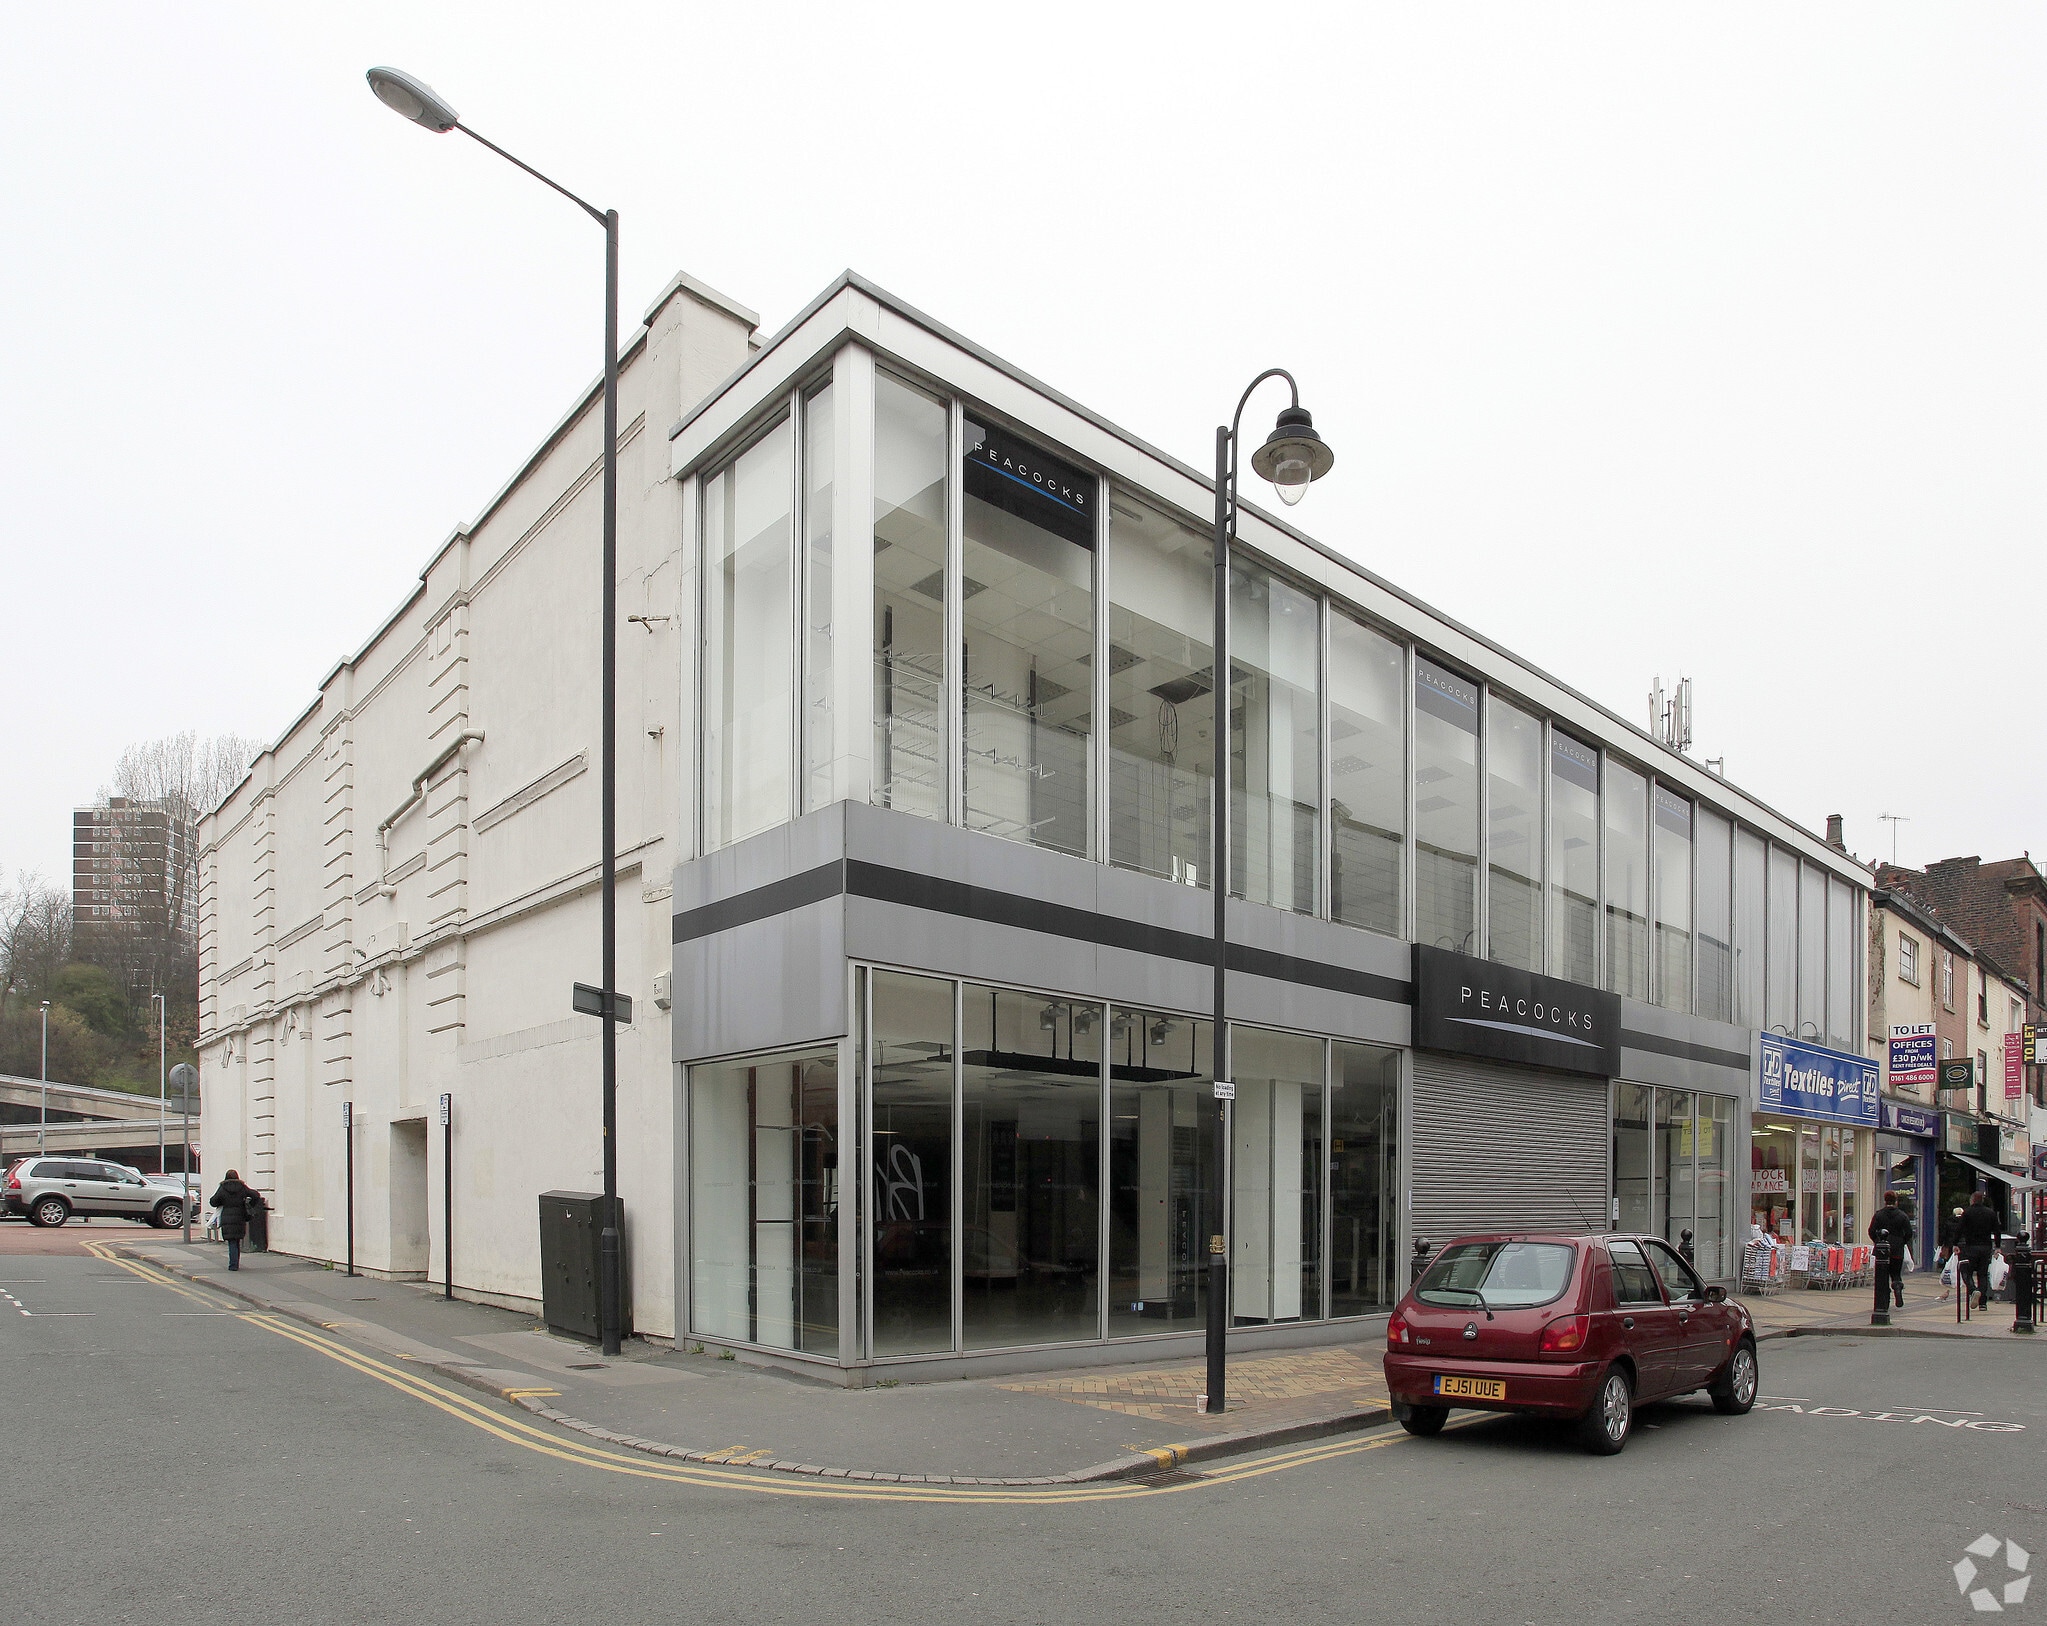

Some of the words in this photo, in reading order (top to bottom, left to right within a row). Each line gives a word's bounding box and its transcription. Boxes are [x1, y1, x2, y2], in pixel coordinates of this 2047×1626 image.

[974, 441, 1084, 505] PEACOCKS
[1418, 669, 1475, 705] PEACOCKS
[1553, 739, 1596, 768] PEACOCKS
[1656, 794, 1689, 817] PEACOCKS
[1461, 986, 1593, 1030] PEACOCKS
[1893, 1026, 1909, 1035] TO
[1911, 1025, 1932, 1034] LET
[2024, 1024, 2035, 1045] LET
[1892, 1040, 1933, 1049] OFFICES
[2024, 1047, 2035, 1062] TO
[1892, 1054, 1909, 1063] £30
[1910, 1052, 1933, 1063] p/wk
[1784, 1063, 1834, 1097] Textiles
[1837, 1077, 1861, 1096] Direct
[1752, 1169, 1784, 1180] TOCK
[1751, 1180, 1784, 1191] ARANCE
[1444, 1378, 1473, 1395] EJ51
[1475, 1381, 1501, 1397] UUE
[1752, 1401, 2027, 1432] ADING
